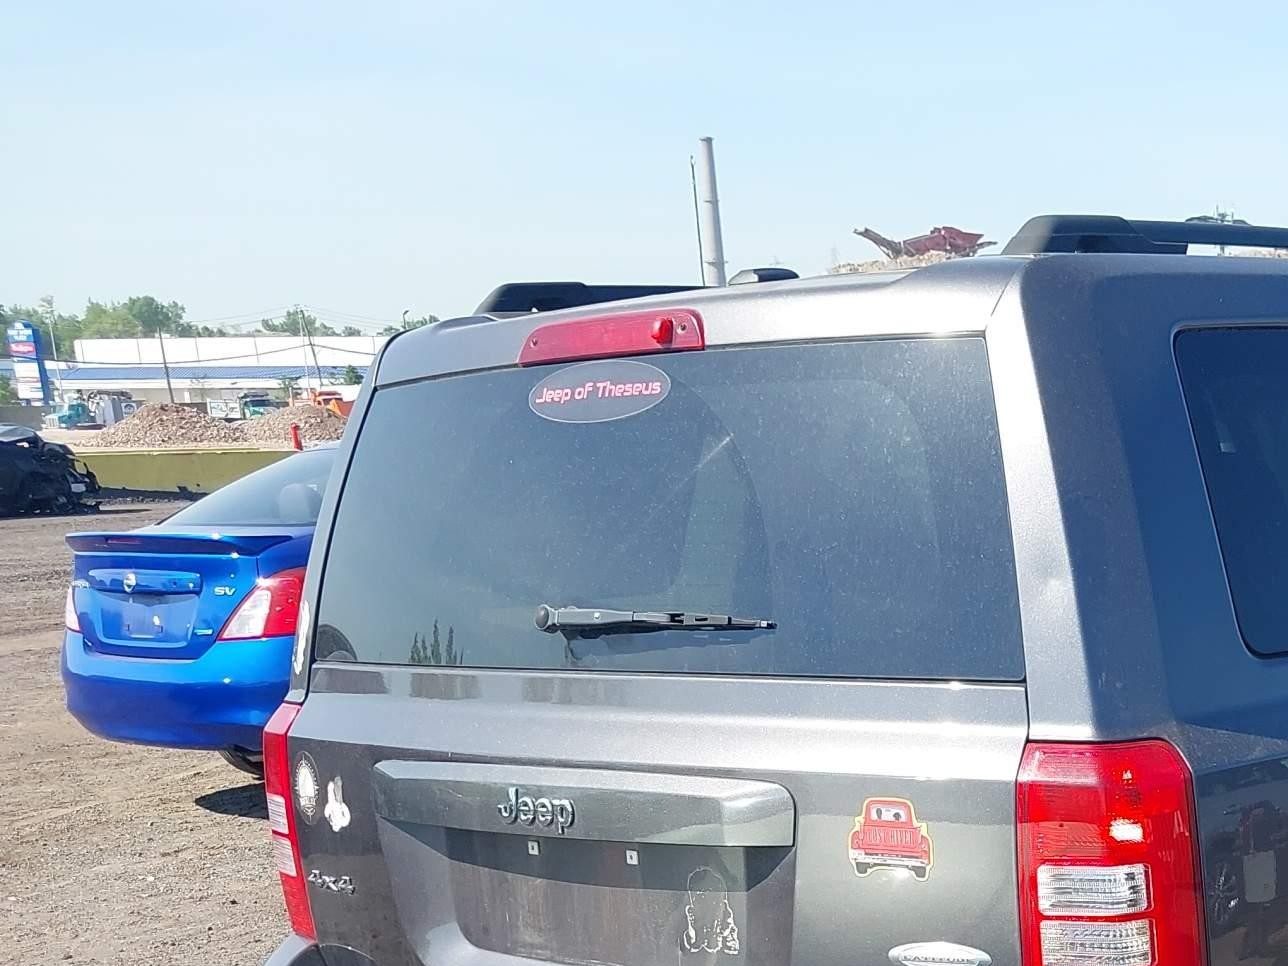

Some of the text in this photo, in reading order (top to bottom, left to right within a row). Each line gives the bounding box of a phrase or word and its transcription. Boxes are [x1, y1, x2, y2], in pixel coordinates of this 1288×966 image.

[535, 381, 662, 405] Jeep of Theseus
[213, 586, 236, 596] SV
[497, 787, 576, 835] Jeep
[307, 869, 357, 897] 4x4
